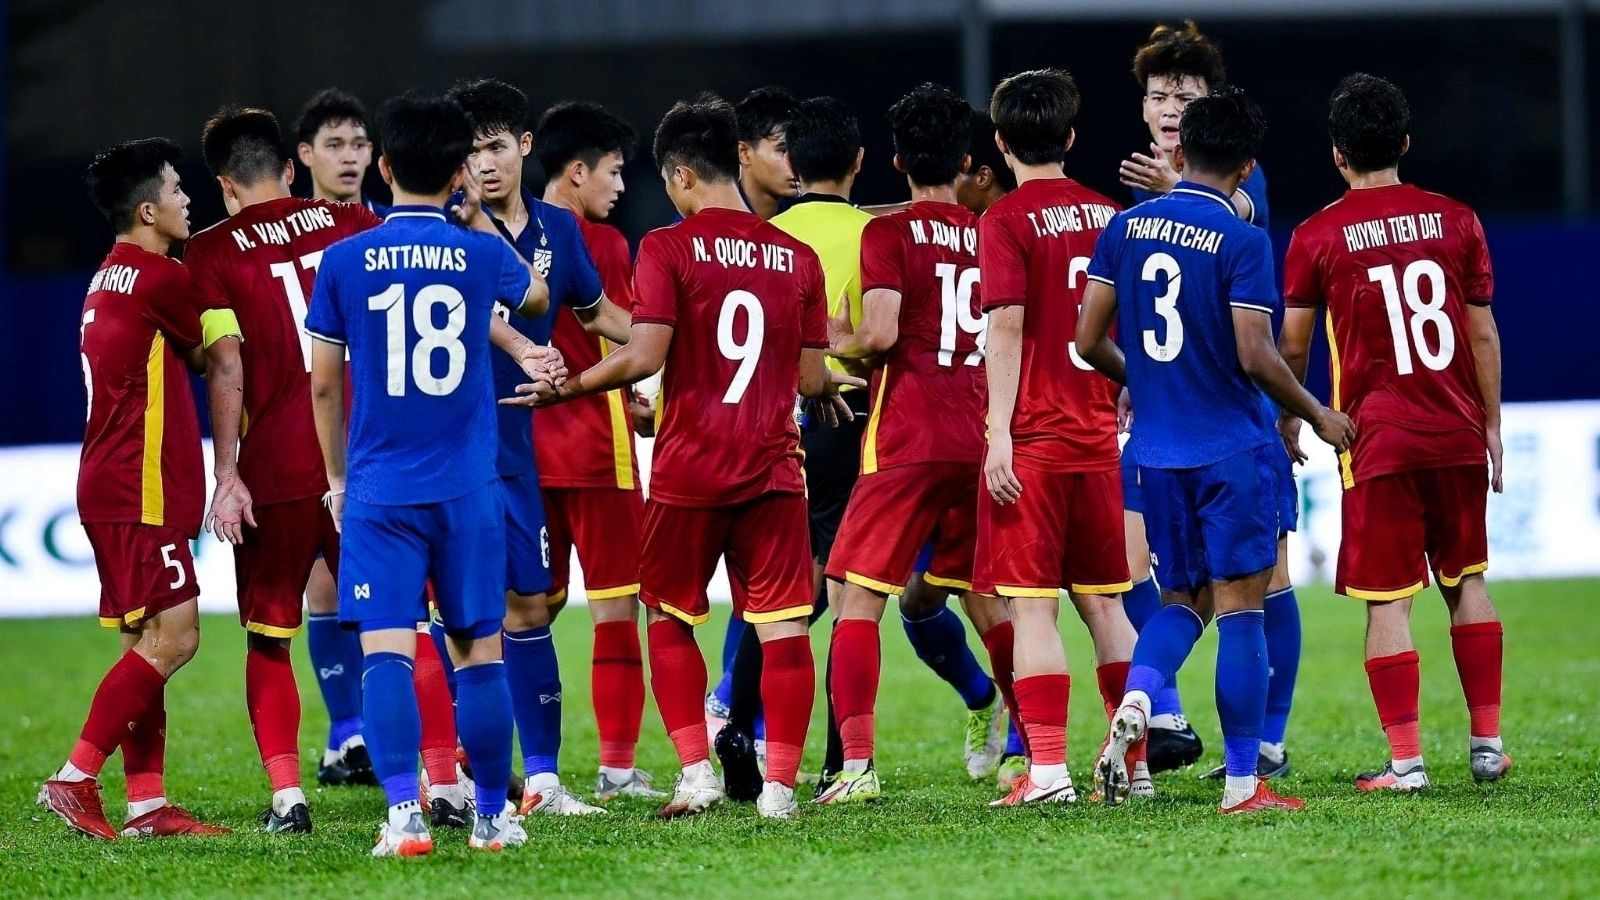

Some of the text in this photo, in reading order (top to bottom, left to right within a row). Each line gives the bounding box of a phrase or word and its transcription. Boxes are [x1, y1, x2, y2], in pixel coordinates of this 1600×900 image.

[231, 206, 336, 252] N. VAN TUNG
[909, 220, 928, 244] M.
[1126, 217, 1224, 254] THAWATCHAI
[1343, 213, 1443, 252] HUYNH TIEN DAT
[364, 244, 466, 272] SATTAWAS
[692, 237, 794, 273] N. QUOC VIET
[935, 262, 988, 367] 19
[1141, 252, 1184, 362] 3
[1367, 260, 1455, 376] 18
[368, 284, 466, 396] 18
[717, 290, 764, 404] 9
[161, 544, 186, 590] 5
